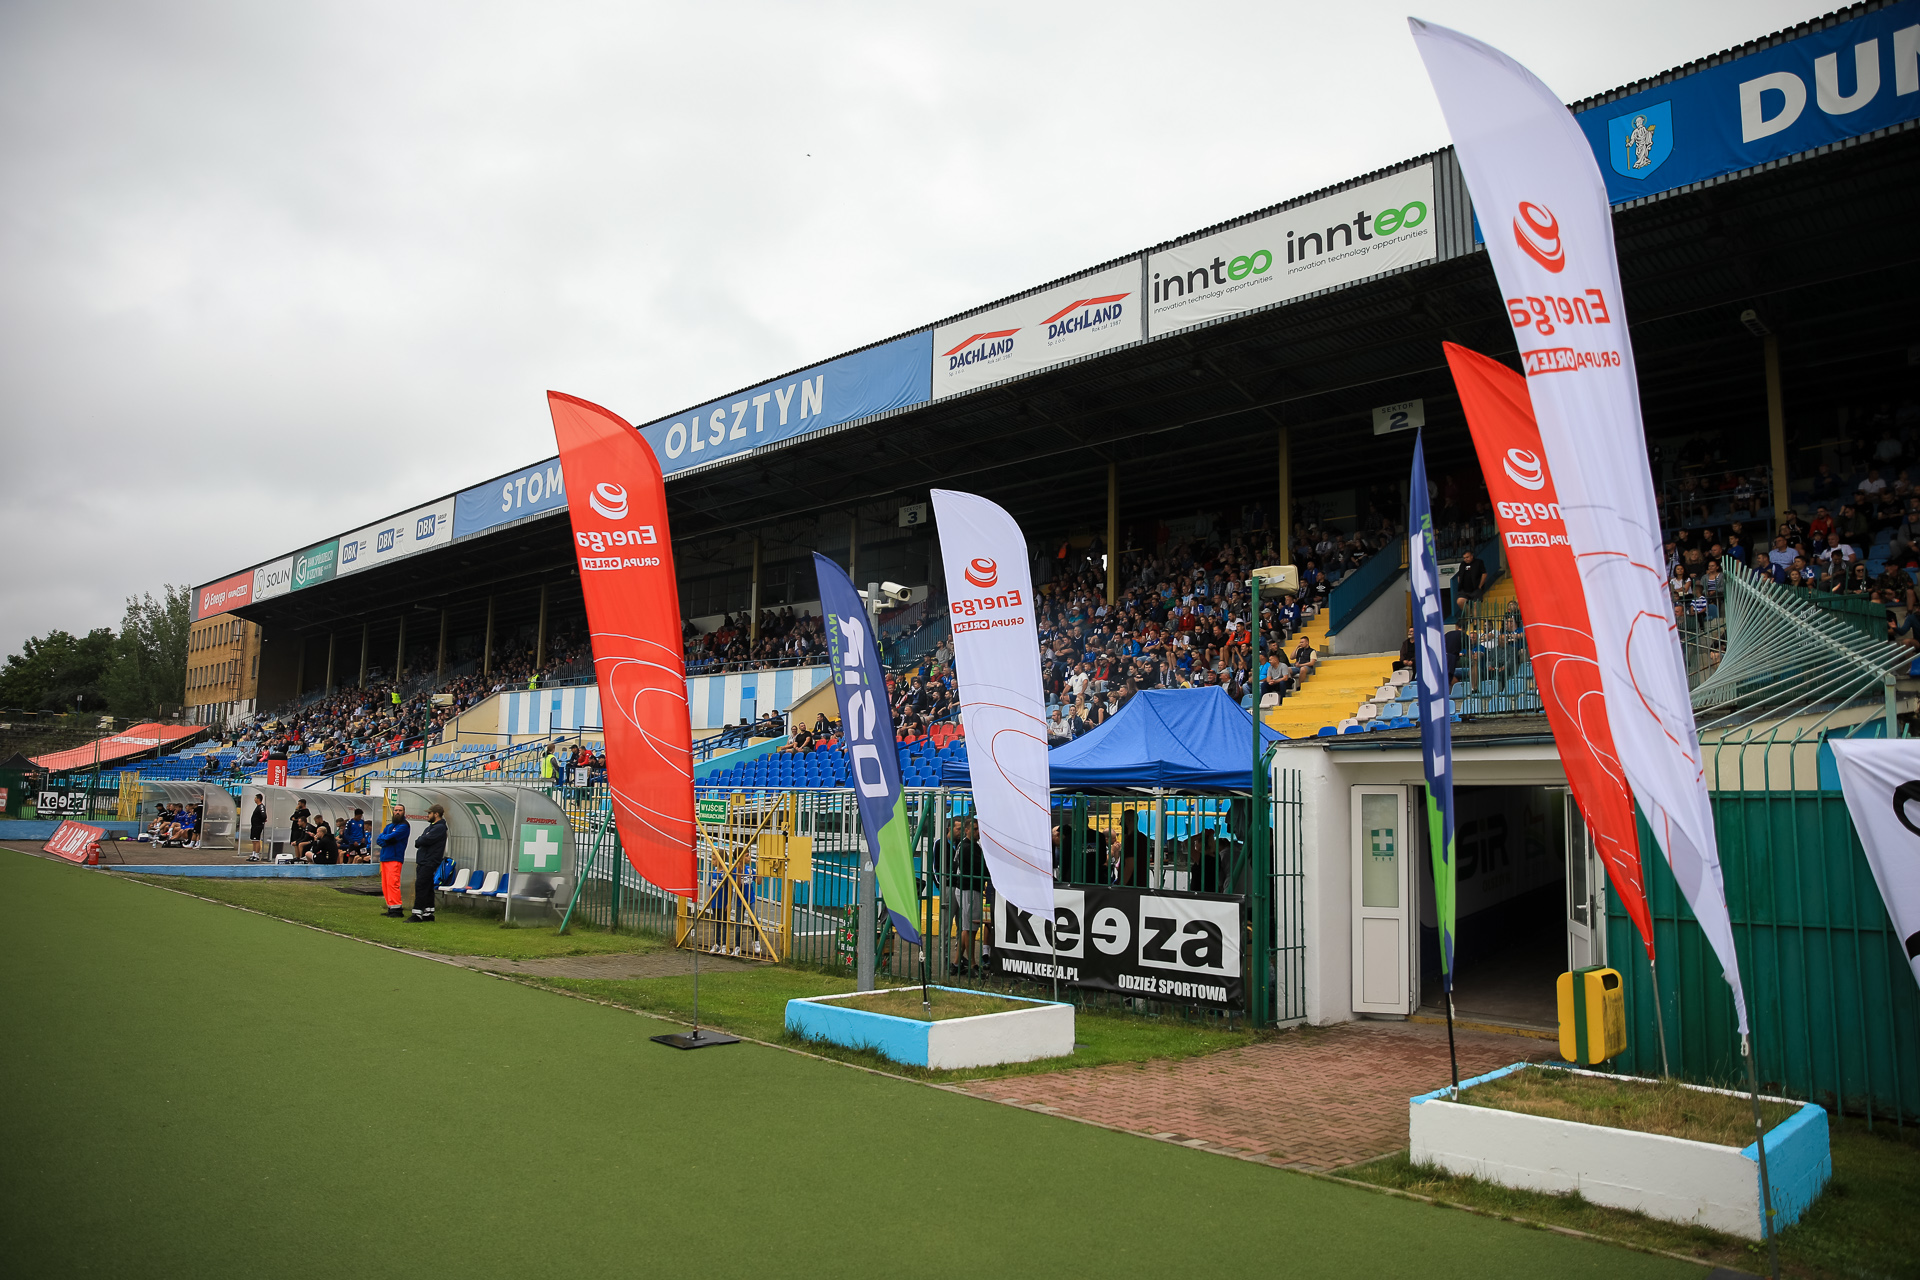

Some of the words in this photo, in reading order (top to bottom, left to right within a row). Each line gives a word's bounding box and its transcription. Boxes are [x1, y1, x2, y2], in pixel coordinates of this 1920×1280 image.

[1287, 259, 1326, 275] innovation
[1328, 245, 1371, 264] technology
[1372, 228, 1428, 250] opportunities
[1153, 300, 1187, 314] innovation
[1188, 289, 1225, 305] technology
[1225, 275, 1274, 294] opportunities
[664, 374, 825, 460] OLSZTYN
[1381, 402, 1415, 414] SEKTOR
[1389, 412, 1409, 431] 2
[501, 464, 564, 513] STOM
[417, 516, 435, 538] DBK
[907, 511, 918, 524] 3
[378, 530, 394, 550] DBK
[343, 543, 358, 562] DBK
[266, 568, 290, 588] SOLIN
[210, 592, 226, 607] Energa
[700, 803, 724, 813] WYJŚCIE
[1002, 958, 1080, 982] WWW.KEEZA.PL
[1118, 973, 1157, 993] ODZIEŻ
[1159, 979, 1228, 1003] SPORTOWA
